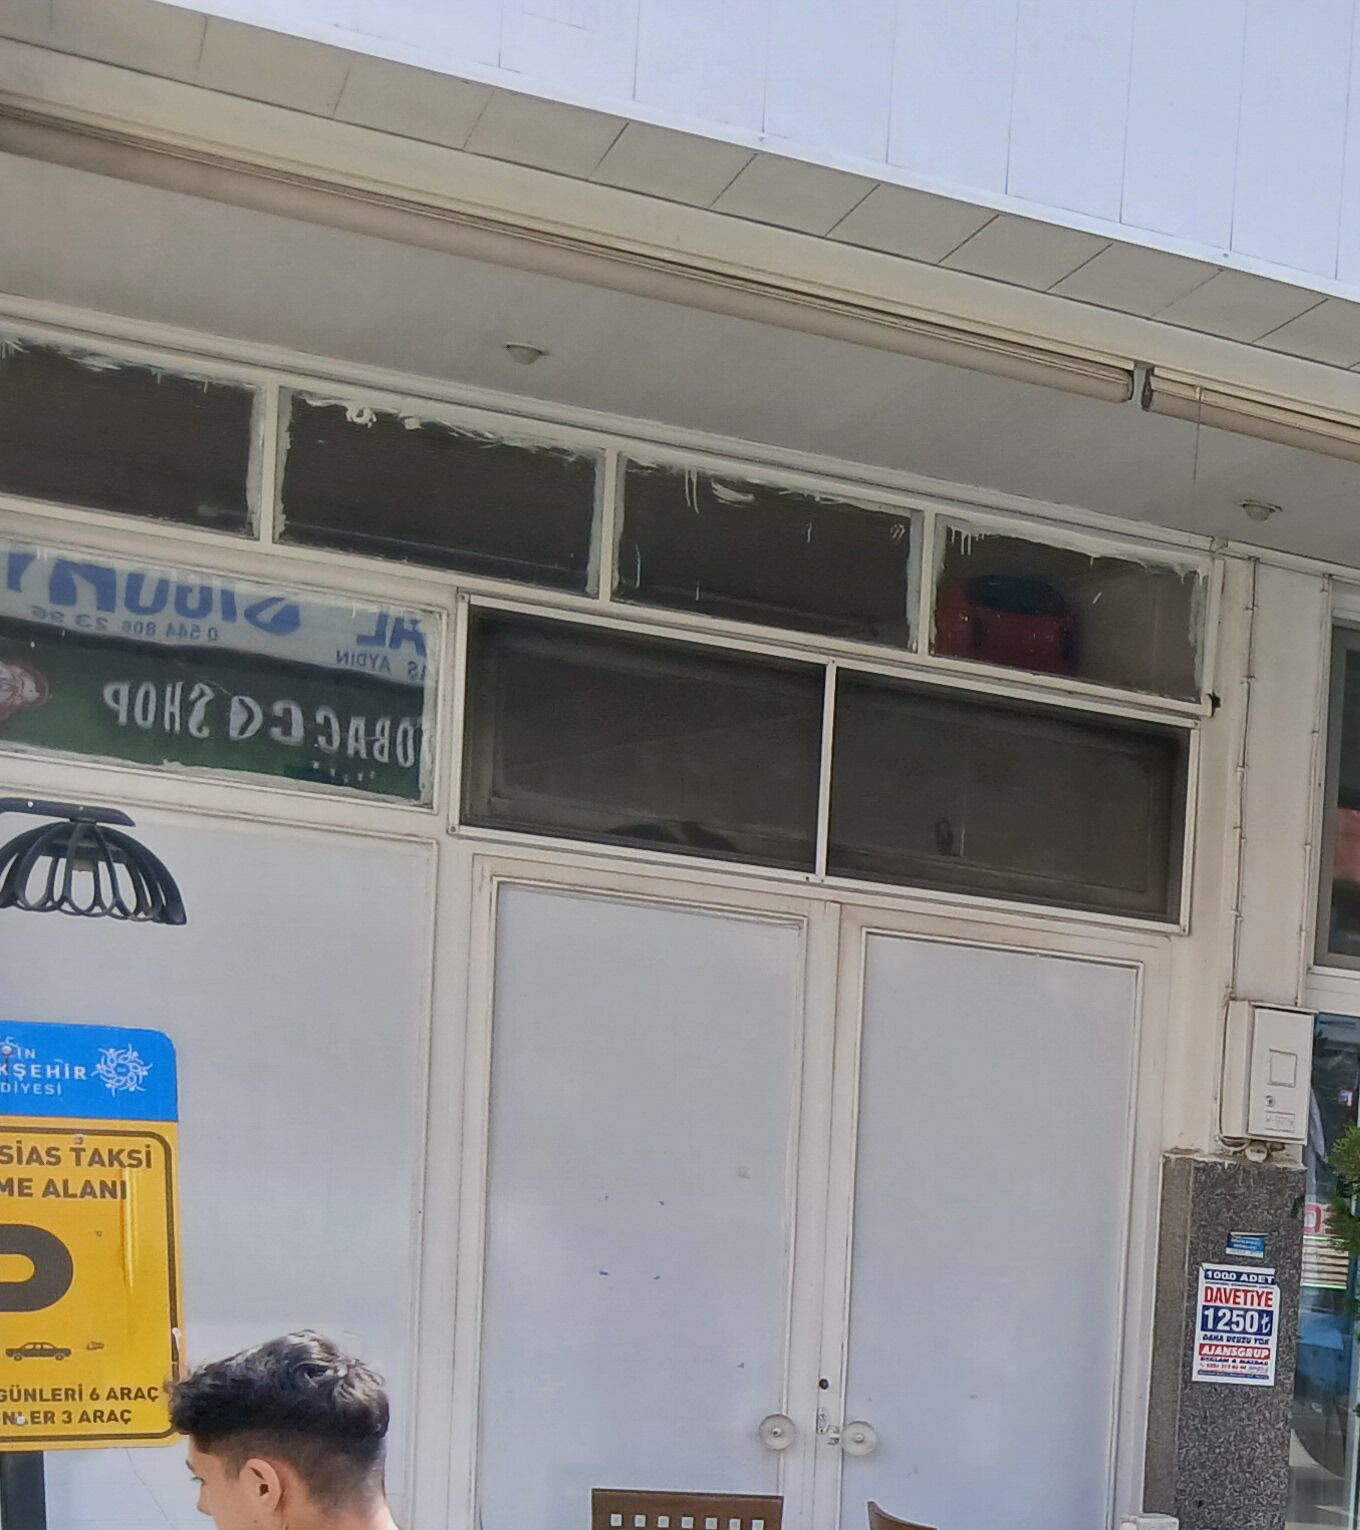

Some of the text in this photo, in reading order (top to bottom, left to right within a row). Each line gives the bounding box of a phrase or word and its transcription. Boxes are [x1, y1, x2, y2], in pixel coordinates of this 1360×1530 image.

[69, 1144, 152, 1169] TAKSİ
[42, 1178, 127, 1200] ALANI
[1240, 1273, 1275, 1284] ADET
[1204, 1286, 1273, 1308] DAVETİYE
[89, 1387, 100, 1401] 6
[106, 1386, 159, 1402] ARAÇ
[62, 1411, 73, 1425] 3
[78, 1409, 131, 1425] ARAÇ
